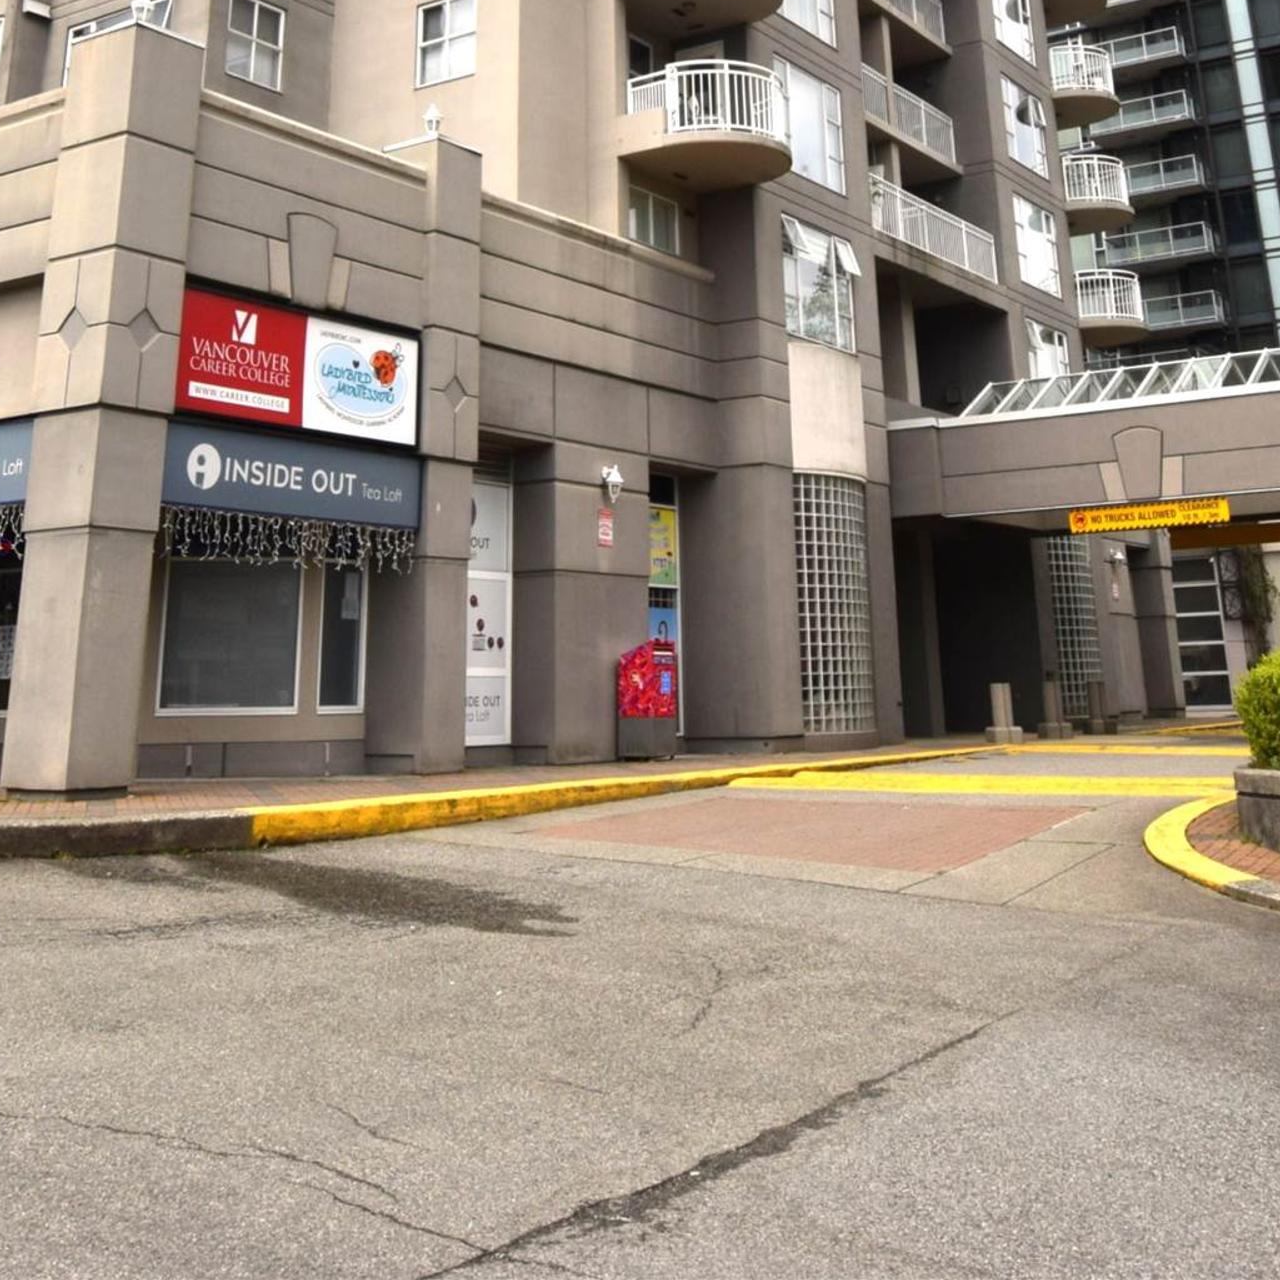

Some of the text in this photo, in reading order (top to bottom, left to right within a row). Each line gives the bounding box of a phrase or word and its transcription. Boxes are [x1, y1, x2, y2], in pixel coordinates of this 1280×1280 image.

[192, 336, 290, 374] VANCOUVER
[189, 356, 290, 388] CAREER COLLEGE
[2, 459, 23, 477] Loft
[224, 457, 402, 503] INSIDE OUT Tea Loft
[471, 537, 490, 549] OUT
[482, 695, 501, 707] OUT
